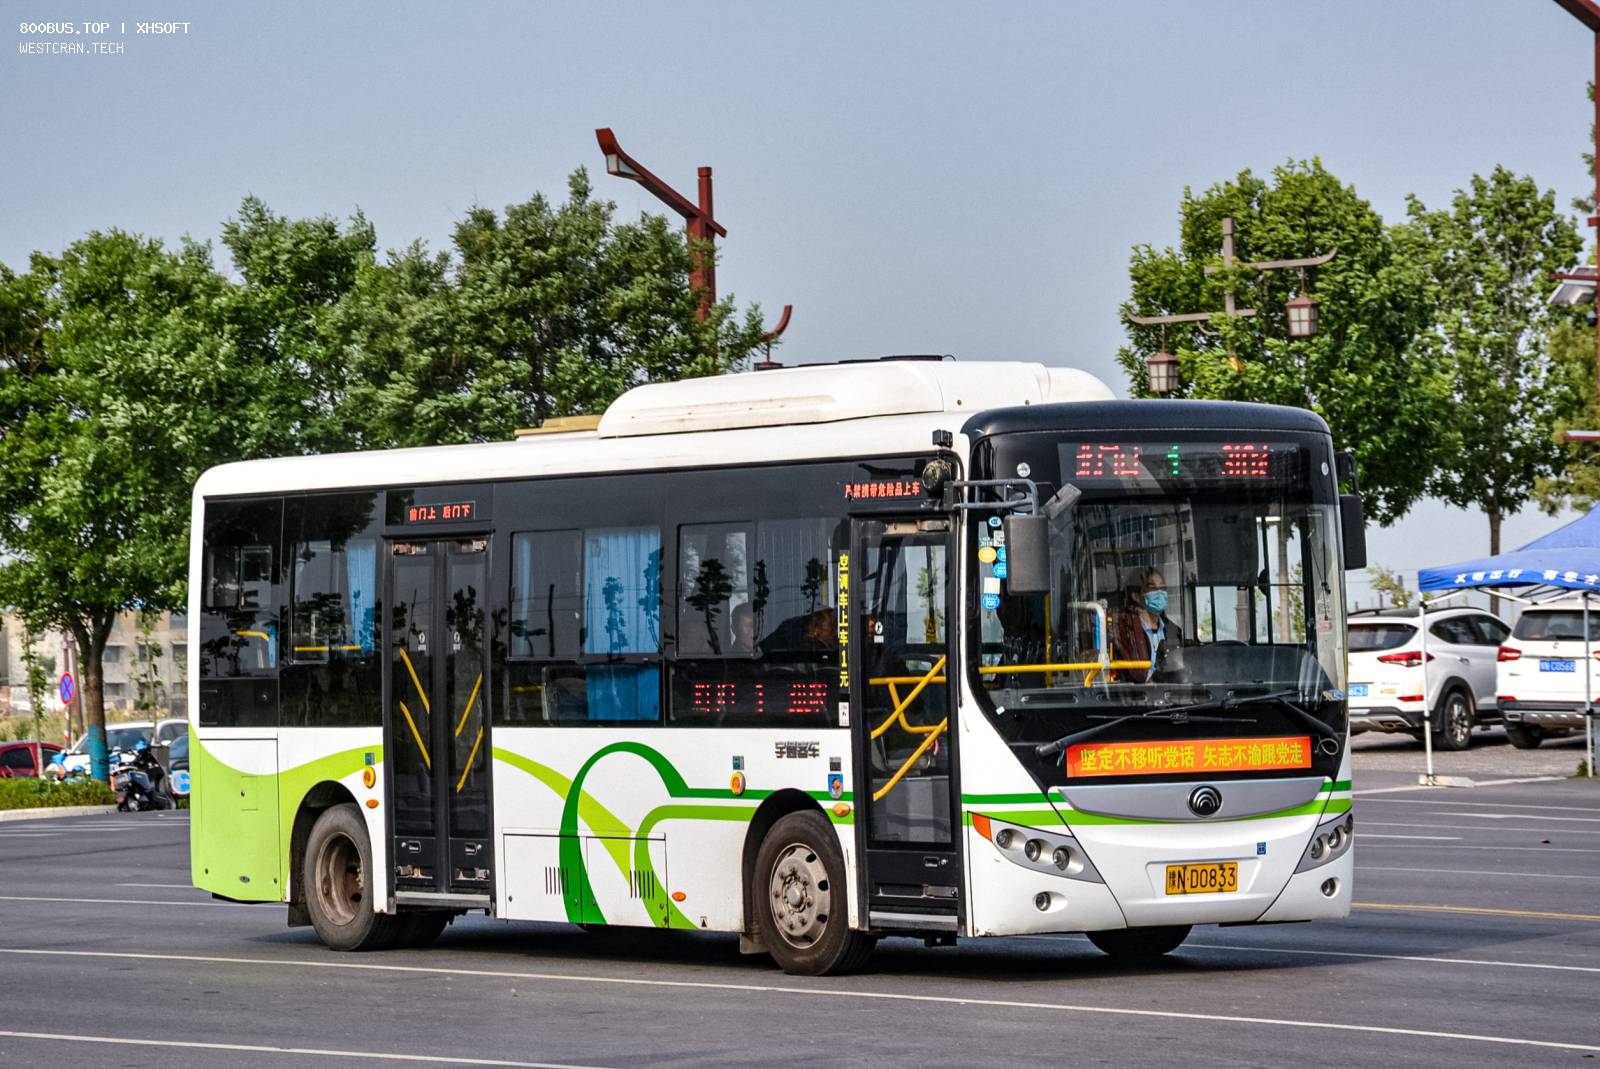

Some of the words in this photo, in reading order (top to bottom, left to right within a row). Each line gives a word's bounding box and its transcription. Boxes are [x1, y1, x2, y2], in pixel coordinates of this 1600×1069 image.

[442, 504, 471, 519] 后门下
[1080, 745, 1196, 772] 坚定不移听党话
[1203, 742, 1304, 768] 矢志不渝跟党走
